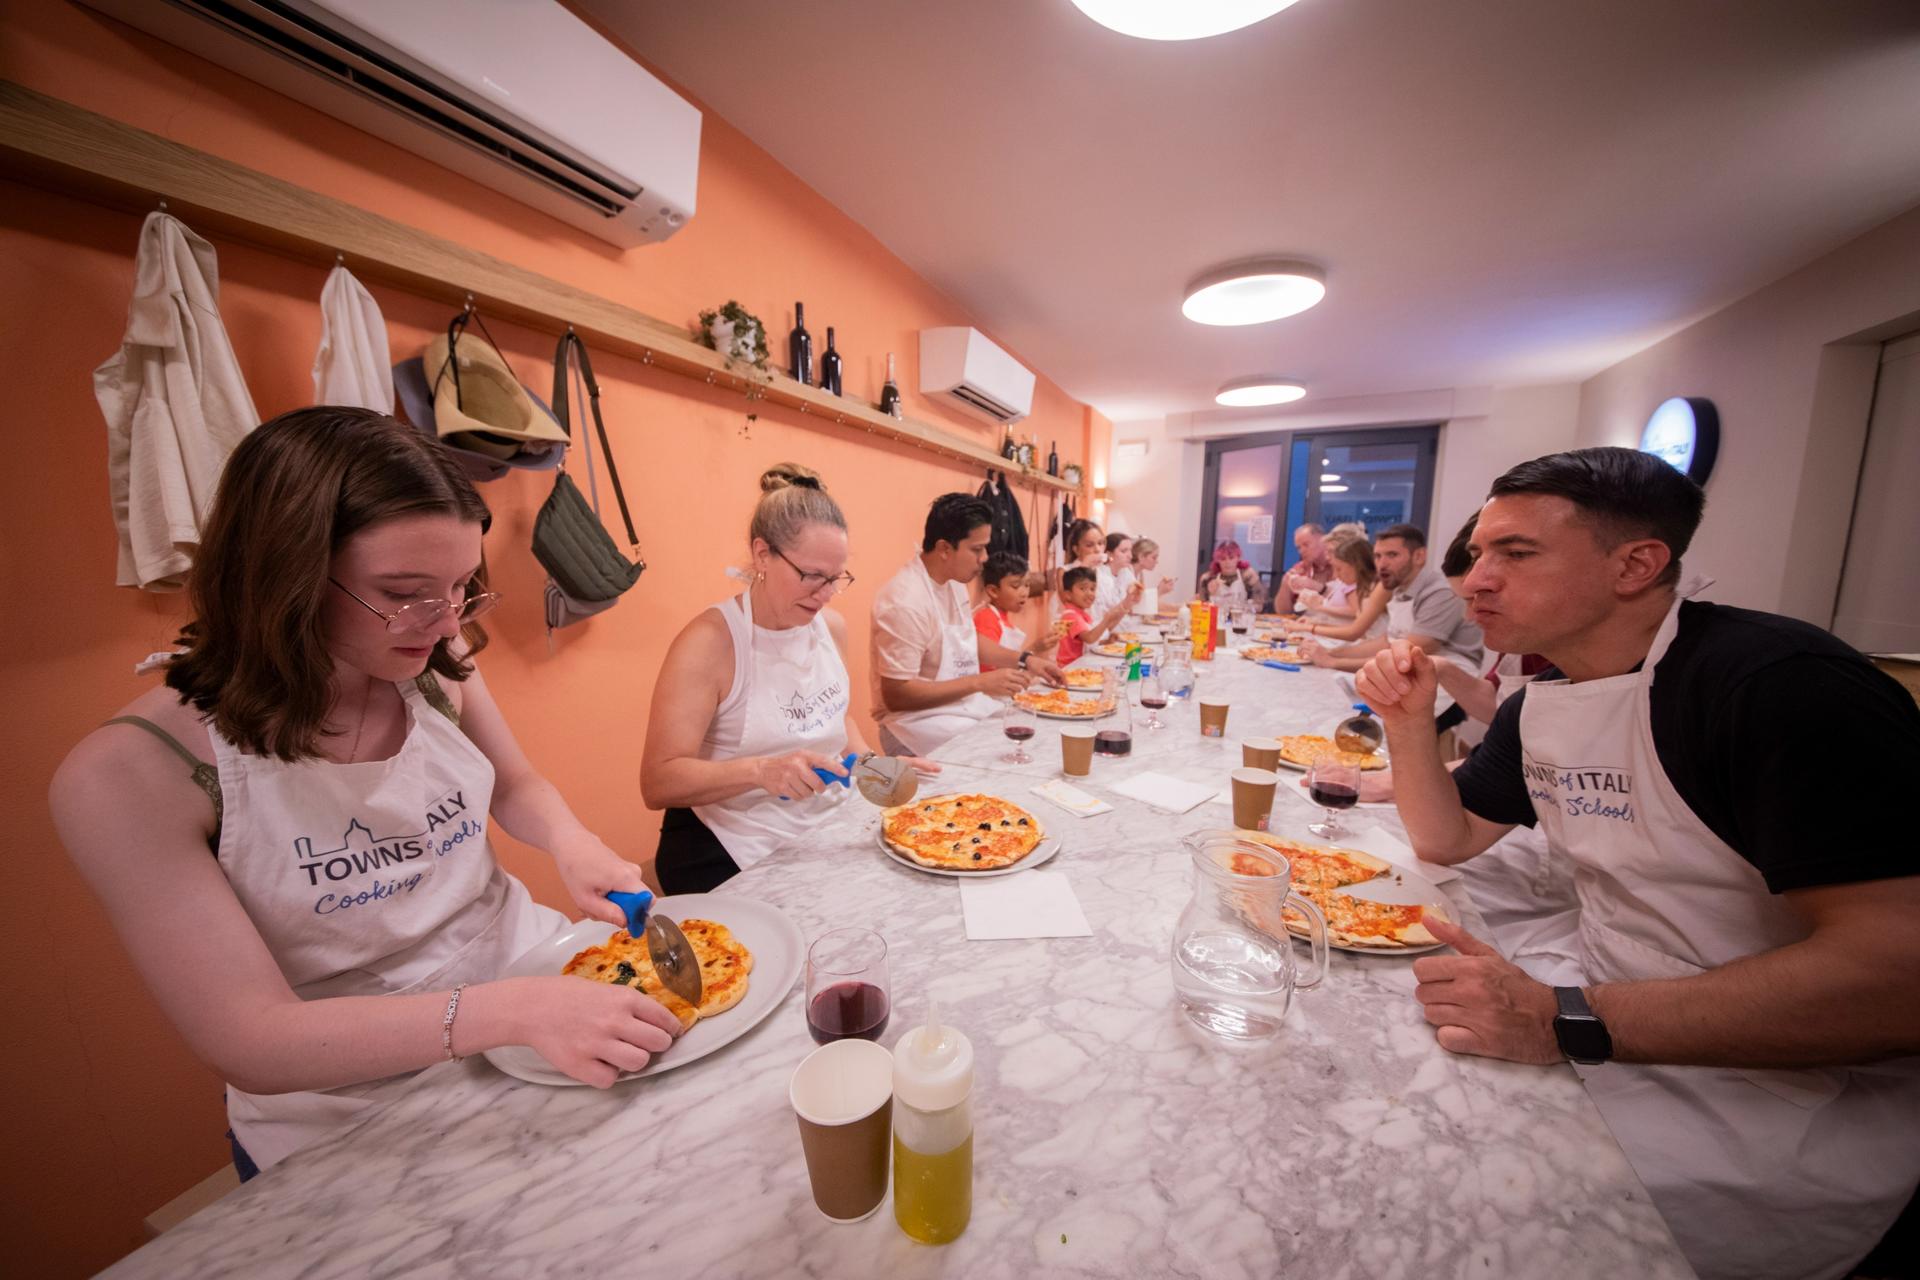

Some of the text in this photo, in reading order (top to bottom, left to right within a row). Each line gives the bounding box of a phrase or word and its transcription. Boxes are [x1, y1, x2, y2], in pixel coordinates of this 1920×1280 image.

[1559, 772, 1573, 791] of
[1566, 796, 1635, 823] Schools
[299, 840, 424, 886] TOWNS
[314, 872, 424, 915] Cooking
